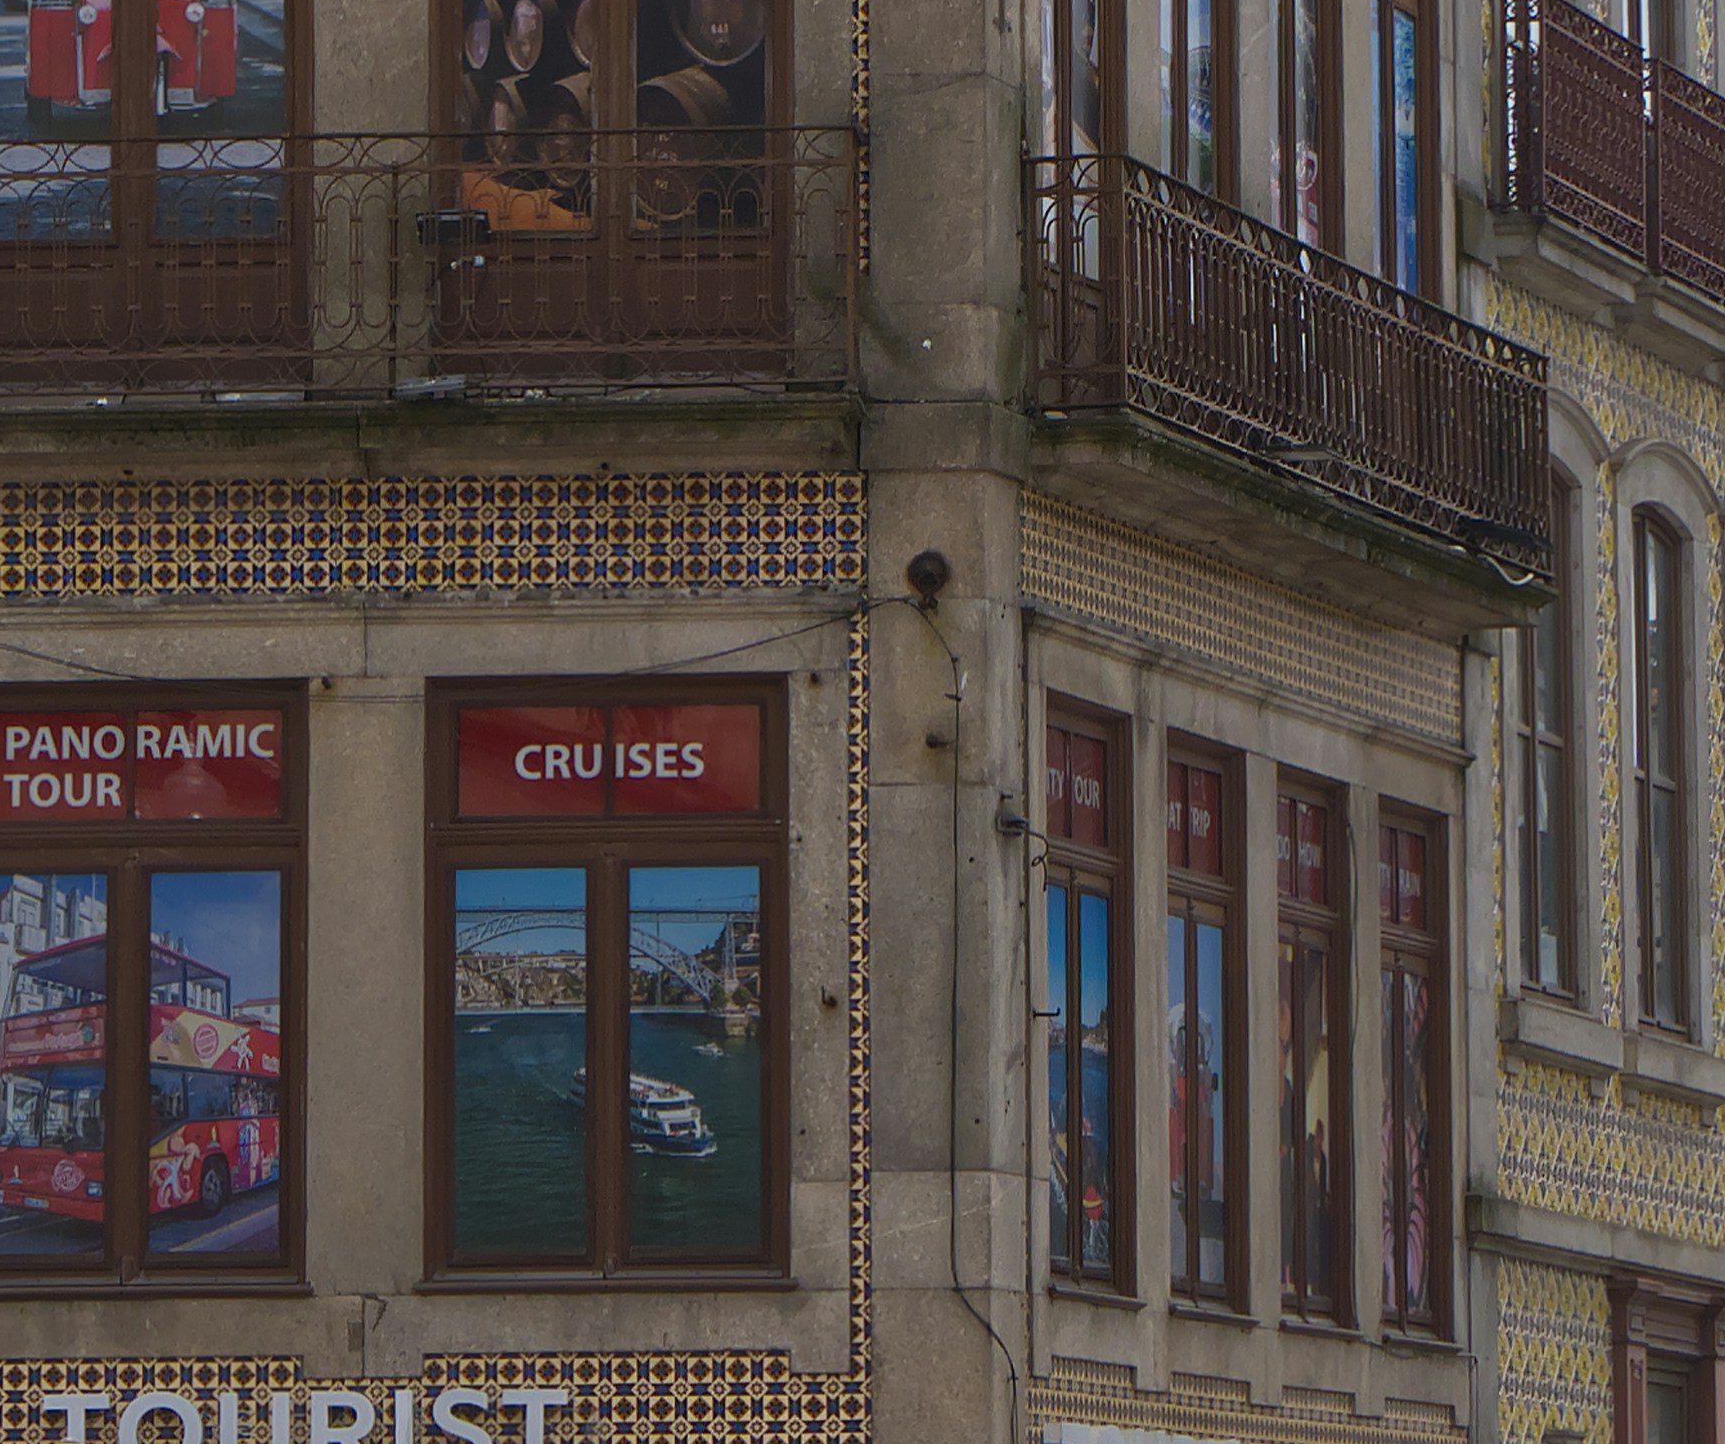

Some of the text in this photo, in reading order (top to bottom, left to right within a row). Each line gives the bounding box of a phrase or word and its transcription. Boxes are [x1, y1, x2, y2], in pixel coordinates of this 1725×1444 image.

[5, 723, 275, 761] PANORAMIC
[514, 743, 705, 781] CRUISES
[3, 772, 122, 808] TOUR
[1072, 774, 1100, 809] OUR
